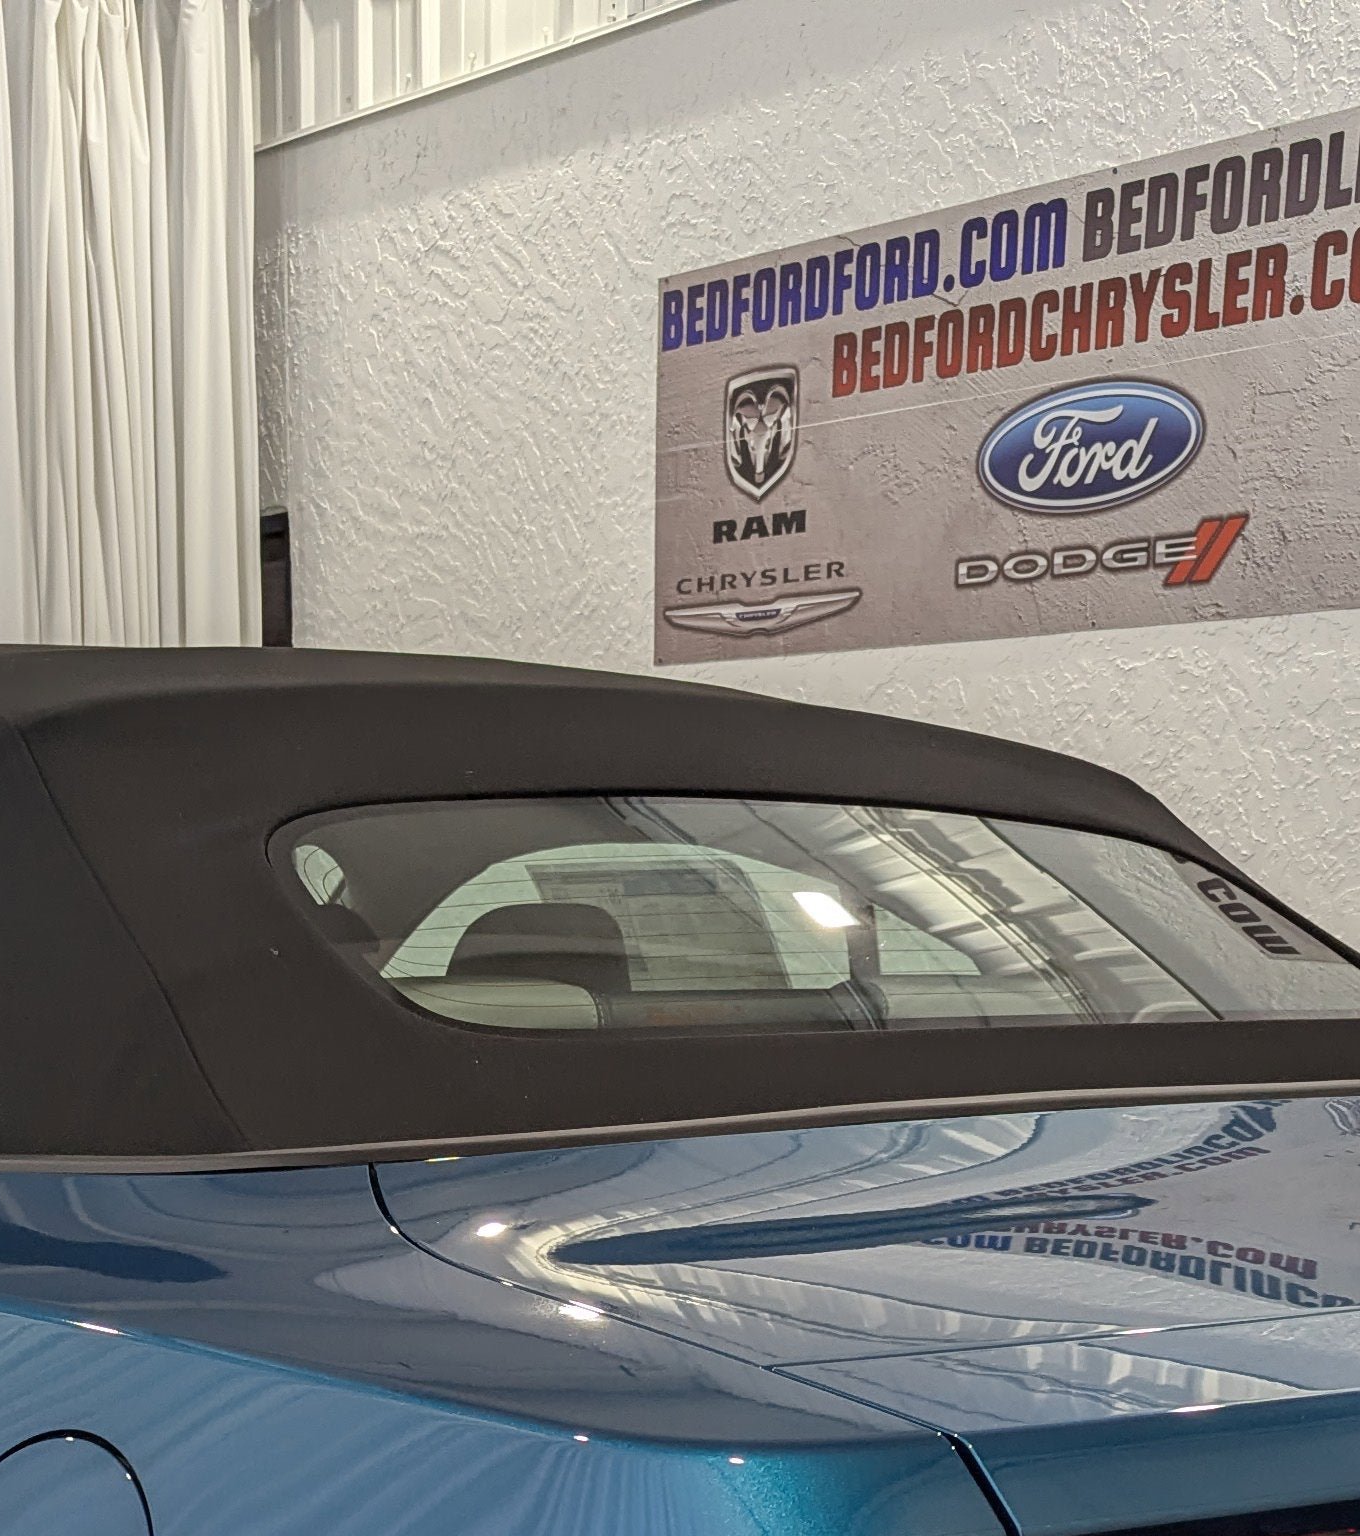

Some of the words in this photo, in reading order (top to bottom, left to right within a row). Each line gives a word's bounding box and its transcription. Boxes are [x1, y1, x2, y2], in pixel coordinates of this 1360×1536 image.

[662, 197, 1067, 352] BEDFORDFORD.COM
[1019, 403, 1159, 493] Ford
[712, 509, 807, 545] RAM
[676, 560, 846, 595] CHRYSLER
[955, 536, 1198, 586] DODGE
